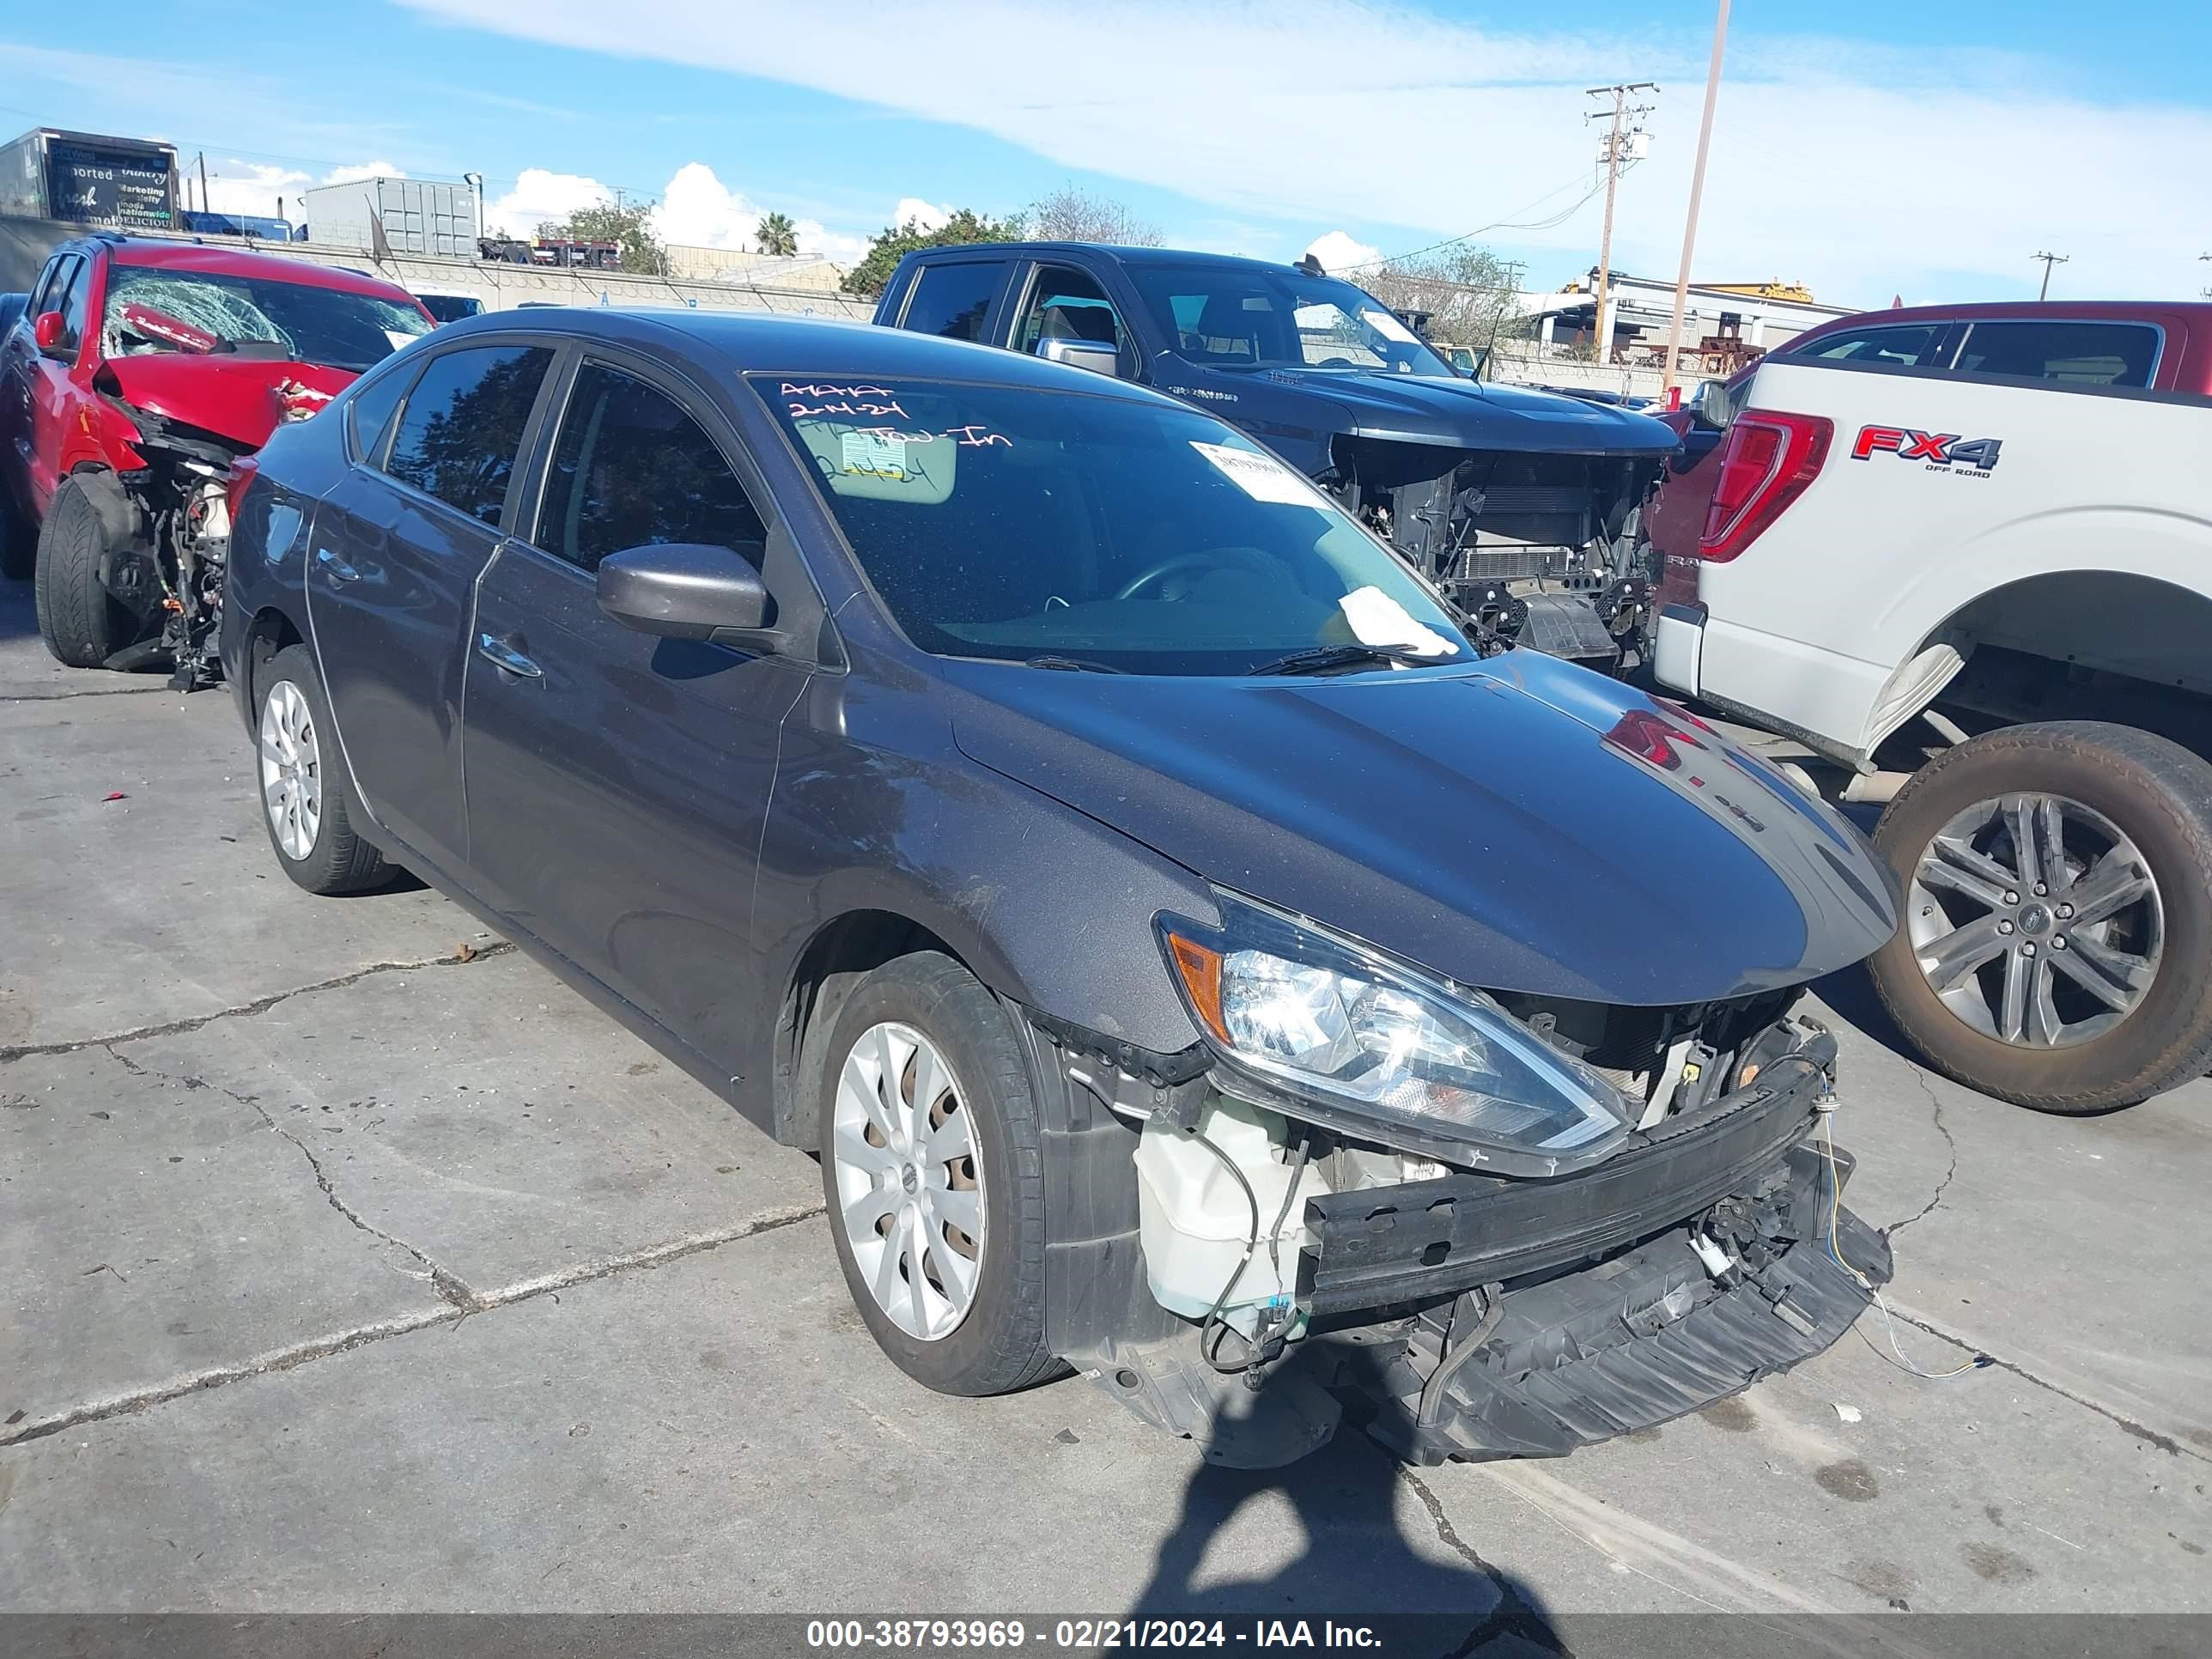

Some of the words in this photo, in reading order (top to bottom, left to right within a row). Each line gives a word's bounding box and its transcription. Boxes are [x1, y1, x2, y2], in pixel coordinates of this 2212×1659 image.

[119, 208, 170, 219] nationwide
[789, 401, 912, 420] 2-14-24
[1850, 424, 2002, 471] FX4
[1924, 465, 1951, 473] OFF
[1955, 468, 1991, 479] ROAD
[1667, 555, 1700, 568] RA
